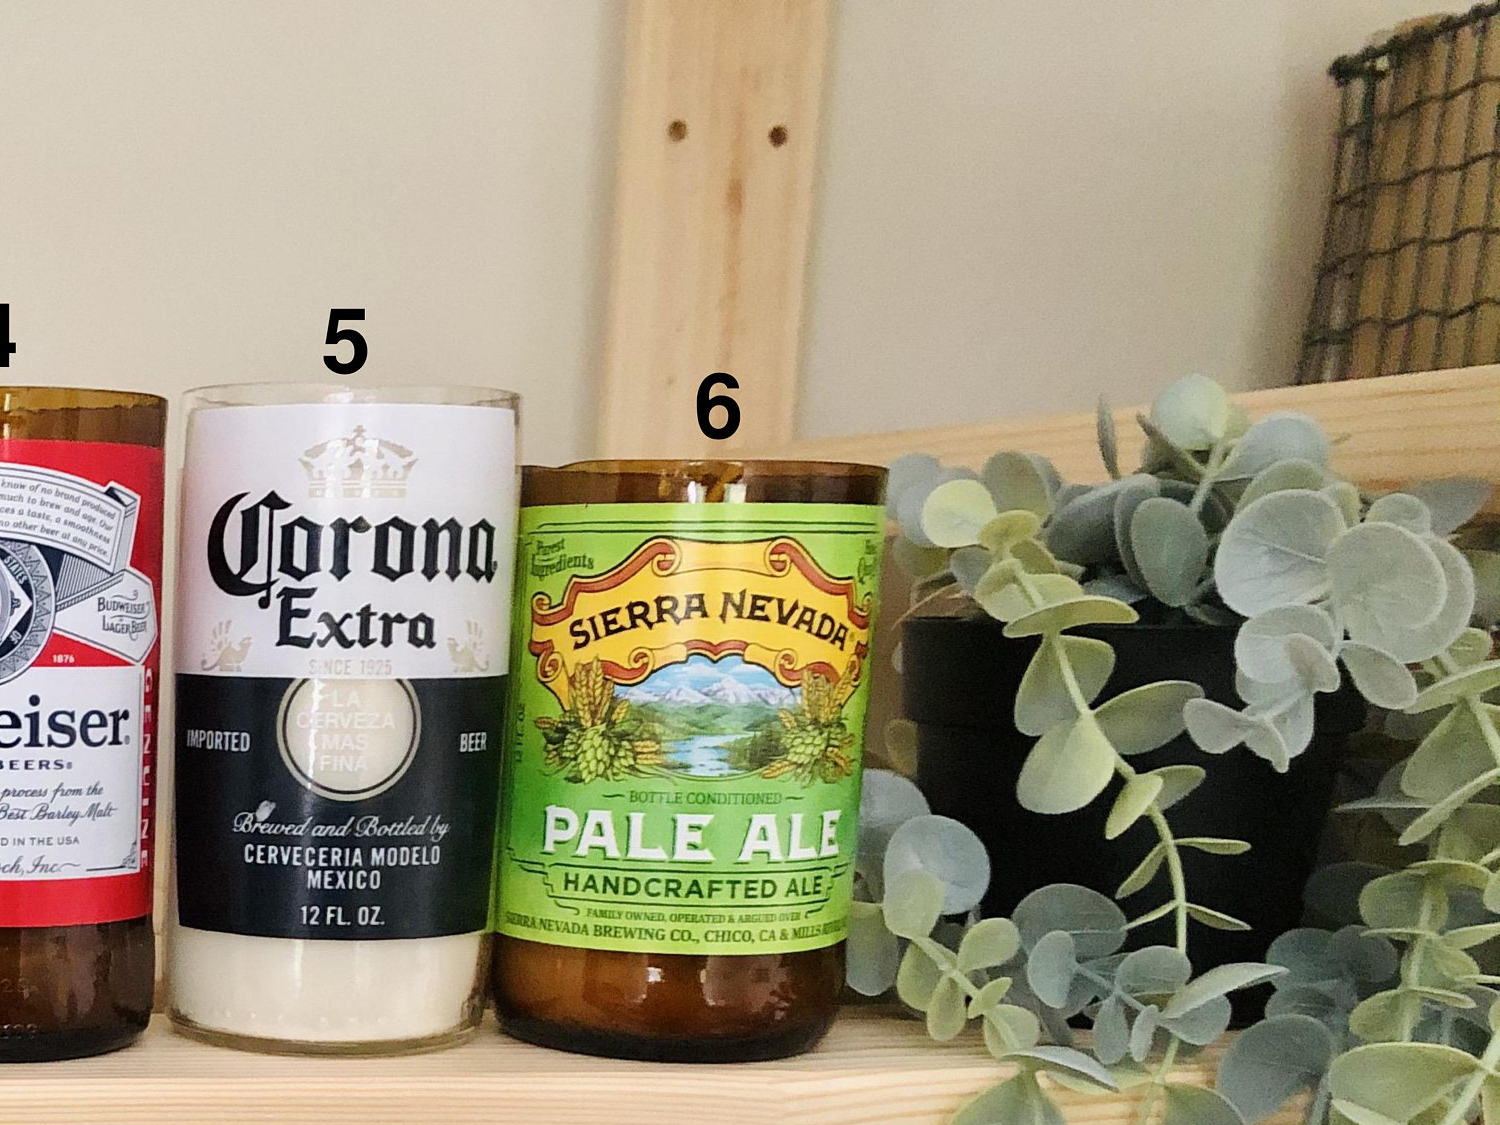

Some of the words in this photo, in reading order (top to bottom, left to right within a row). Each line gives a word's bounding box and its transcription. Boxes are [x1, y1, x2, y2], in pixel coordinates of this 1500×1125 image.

[1, 479, 26, 490] know
[54, 488, 81, 504] brand
[81, 499, 117, 520] produced
[39, 497, 61, 511] brew
[13, 519, 38, 532] other
[63, 520, 111, 544] smoothness
[207, 490, 499, 610] Corona
[3, 555, 28, 585] STATES
[275, 586, 437, 649] Extra
[569, 592, 711, 651] SIERRA
[718, 588, 849, 652] NEVADA
[52, 654, 76, 664] 1876
[360, 659, 393, 676] 1925
[332, 690, 361, 708] LA
[296, 712, 396, 729] CERVEZA
[187, 730, 250, 753] IMPORTED
[321, 733, 367, 751] MAS
[460, 731, 487, 754] BEER
[320, 755, 369, 772] FINA
[0, 785, 49, 802] process
[51, 780, 84, 803] from
[86, 780, 104, 797] the
[629, 790, 684, 805] BOTTLE
[686, 792, 782, 805] CONDITIONED
[30, 802, 80, 828] Barley
[80, 801, 118, 822] Malt
[232, 811, 309, 838] Brewed
[311, 816, 351, 838] and
[354, 815, 430, 839] Bottled
[430, 814, 450, 842] by
[542, 804, 716, 863] PALE
[735, 809, 842, 863] ALE
[13, 836, 25, 846] IN
[29, 836, 54, 847] THE
[57, 836, 80, 846] USA
[244, 843, 363, 866] CERVECERIA
[371, 846, 441, 866] MODELO
[307, 870, 381, 890] MEXICO
[563, 871, 778, 899] HANDCRAFTED
[785, 875, 823, 898] ALE
[301, 906, 320, 925] 12
[326, 906, 351, 926] FL.
[358, 906, 386, 926] OZ.
[586, 907, 622, 921] FAMILY
[625, 910, 667, 923] OWNED,
[669, 913, 726, 924] OPERATED
[737, 913, 777, 924] ARGUED
[778, 911, 800, 922] OVER
[505, 910, 538, 928] SIERRA
[539, 917, 589, 936] NEVADA
[593, 924, 666, 941] BREWING
[669, 929, 700, 944] CO.,
[704, 929, 755, 945] CHICO,
[759, 928, 777, 943] CA
[779, 928, 788, 941] &
[791, 924, 821, 940] MILLS
